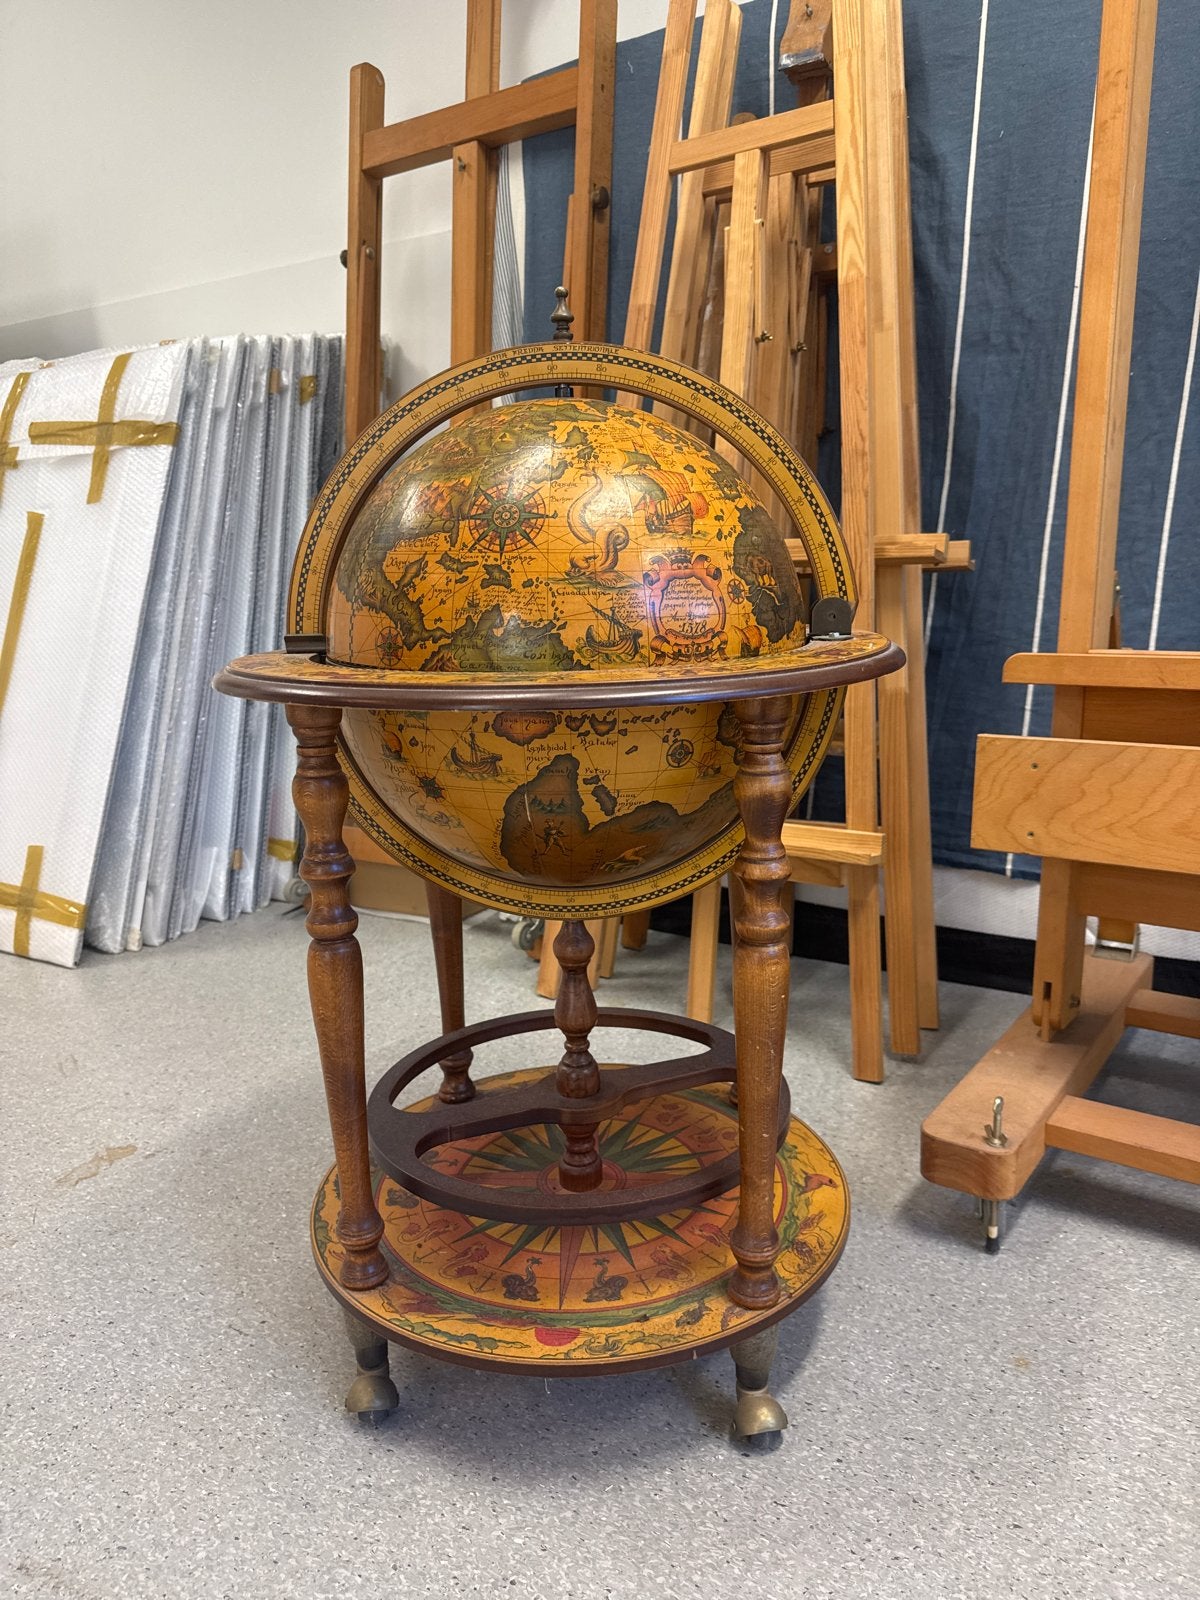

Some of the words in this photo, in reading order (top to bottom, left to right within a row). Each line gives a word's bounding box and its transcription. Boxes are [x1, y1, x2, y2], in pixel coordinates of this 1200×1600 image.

[485, 353, 508, 362] ZONA
[512, 346, 544, 355] FREDDA
[679, 620, 708, 634] 1578
